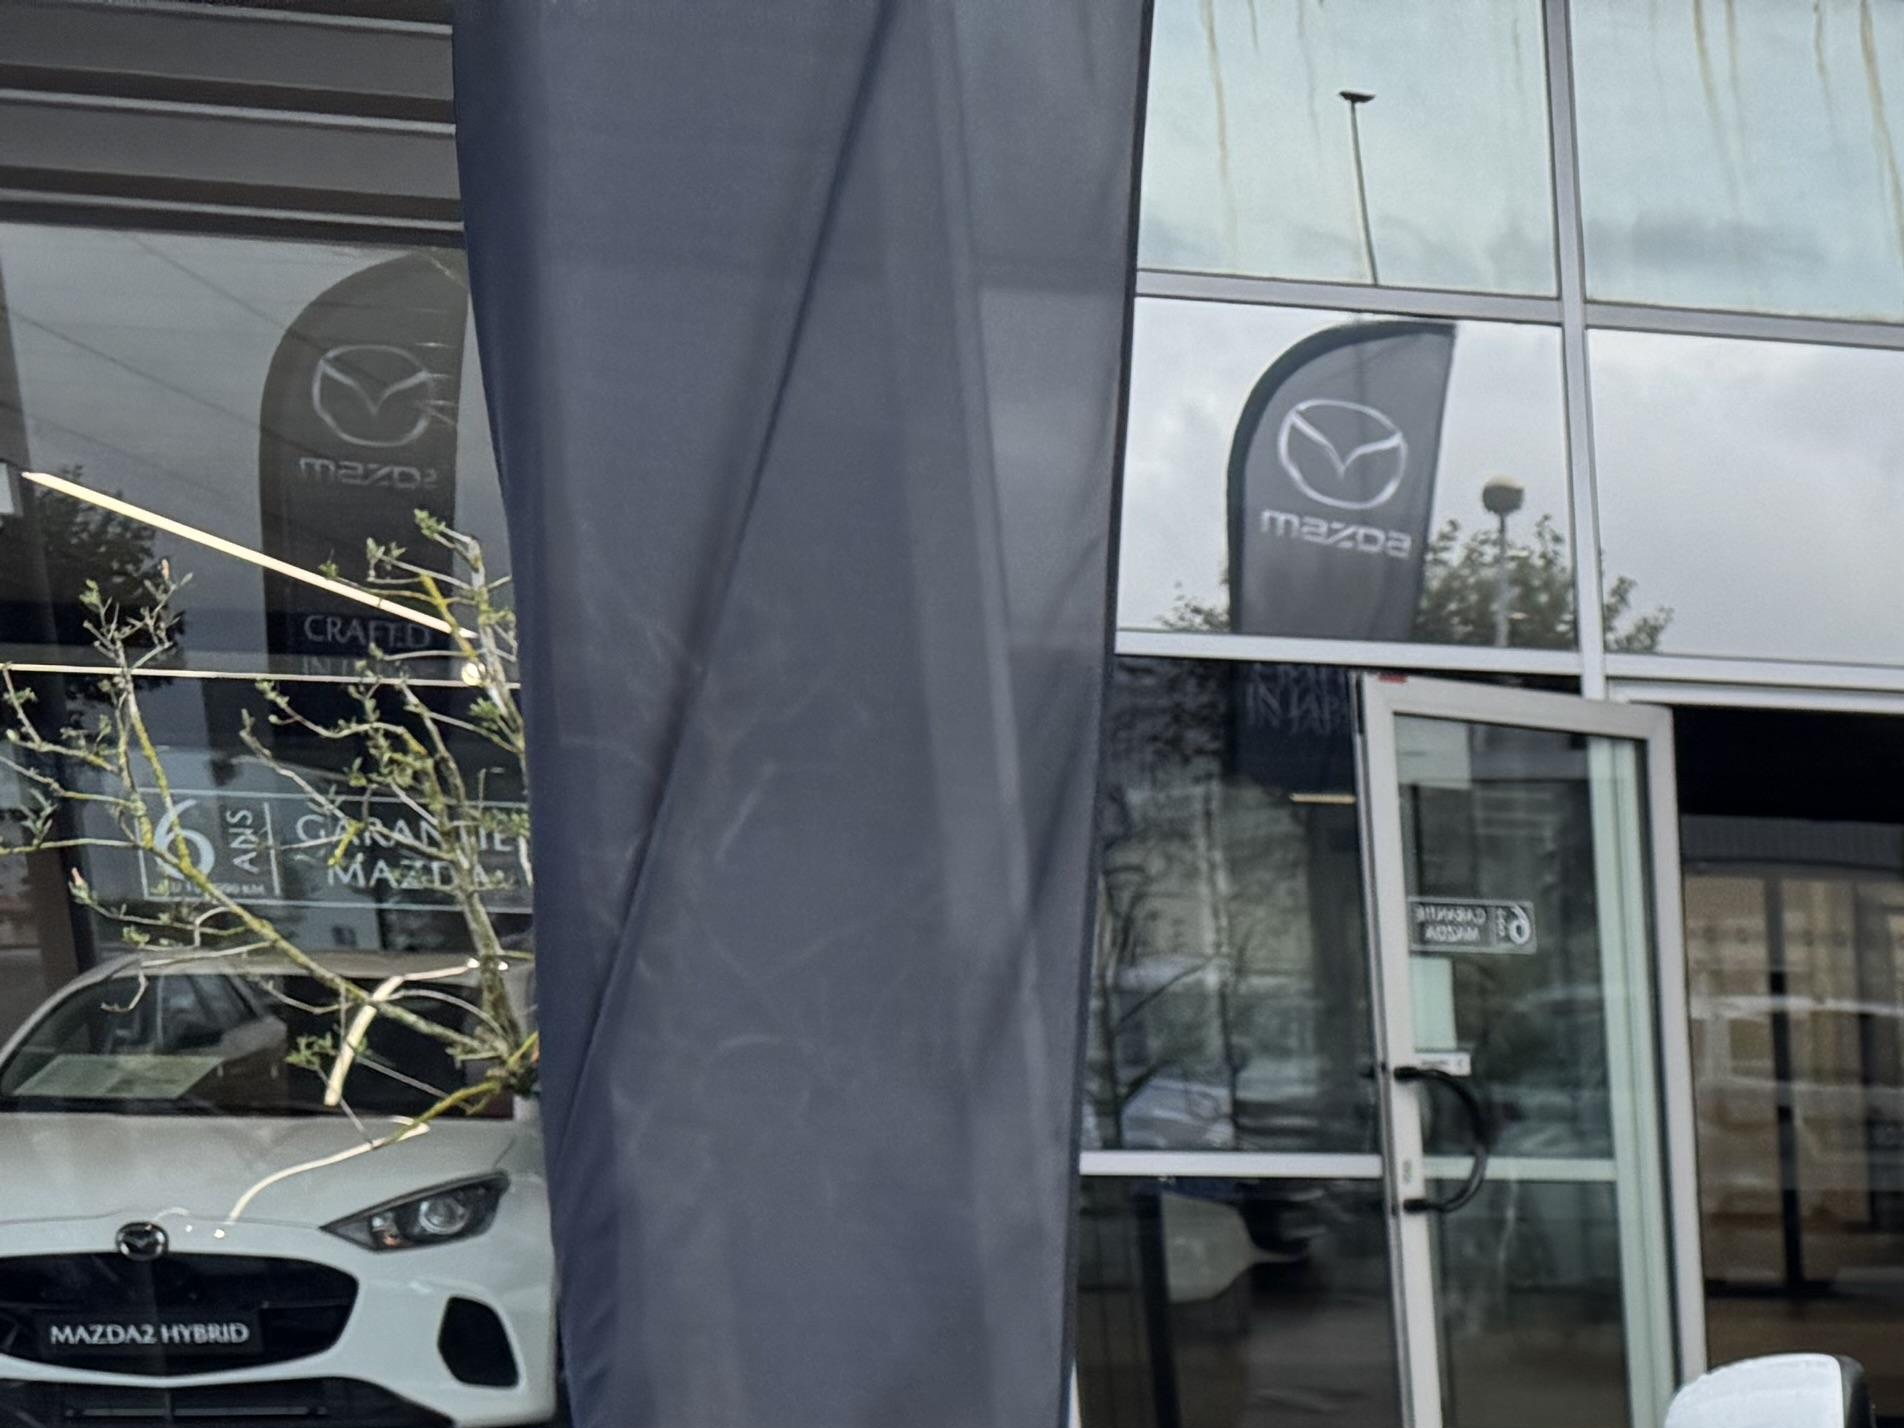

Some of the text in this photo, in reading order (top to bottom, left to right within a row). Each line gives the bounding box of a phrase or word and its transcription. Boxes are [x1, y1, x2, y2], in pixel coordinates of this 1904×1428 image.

[1259, 507, 1412, 558] mazda
[154, 798, 215, 882] 6
[226, 809, 260, 874] ANS
[49, 1321, 250, 1345] MAZDA2 HYBRID
